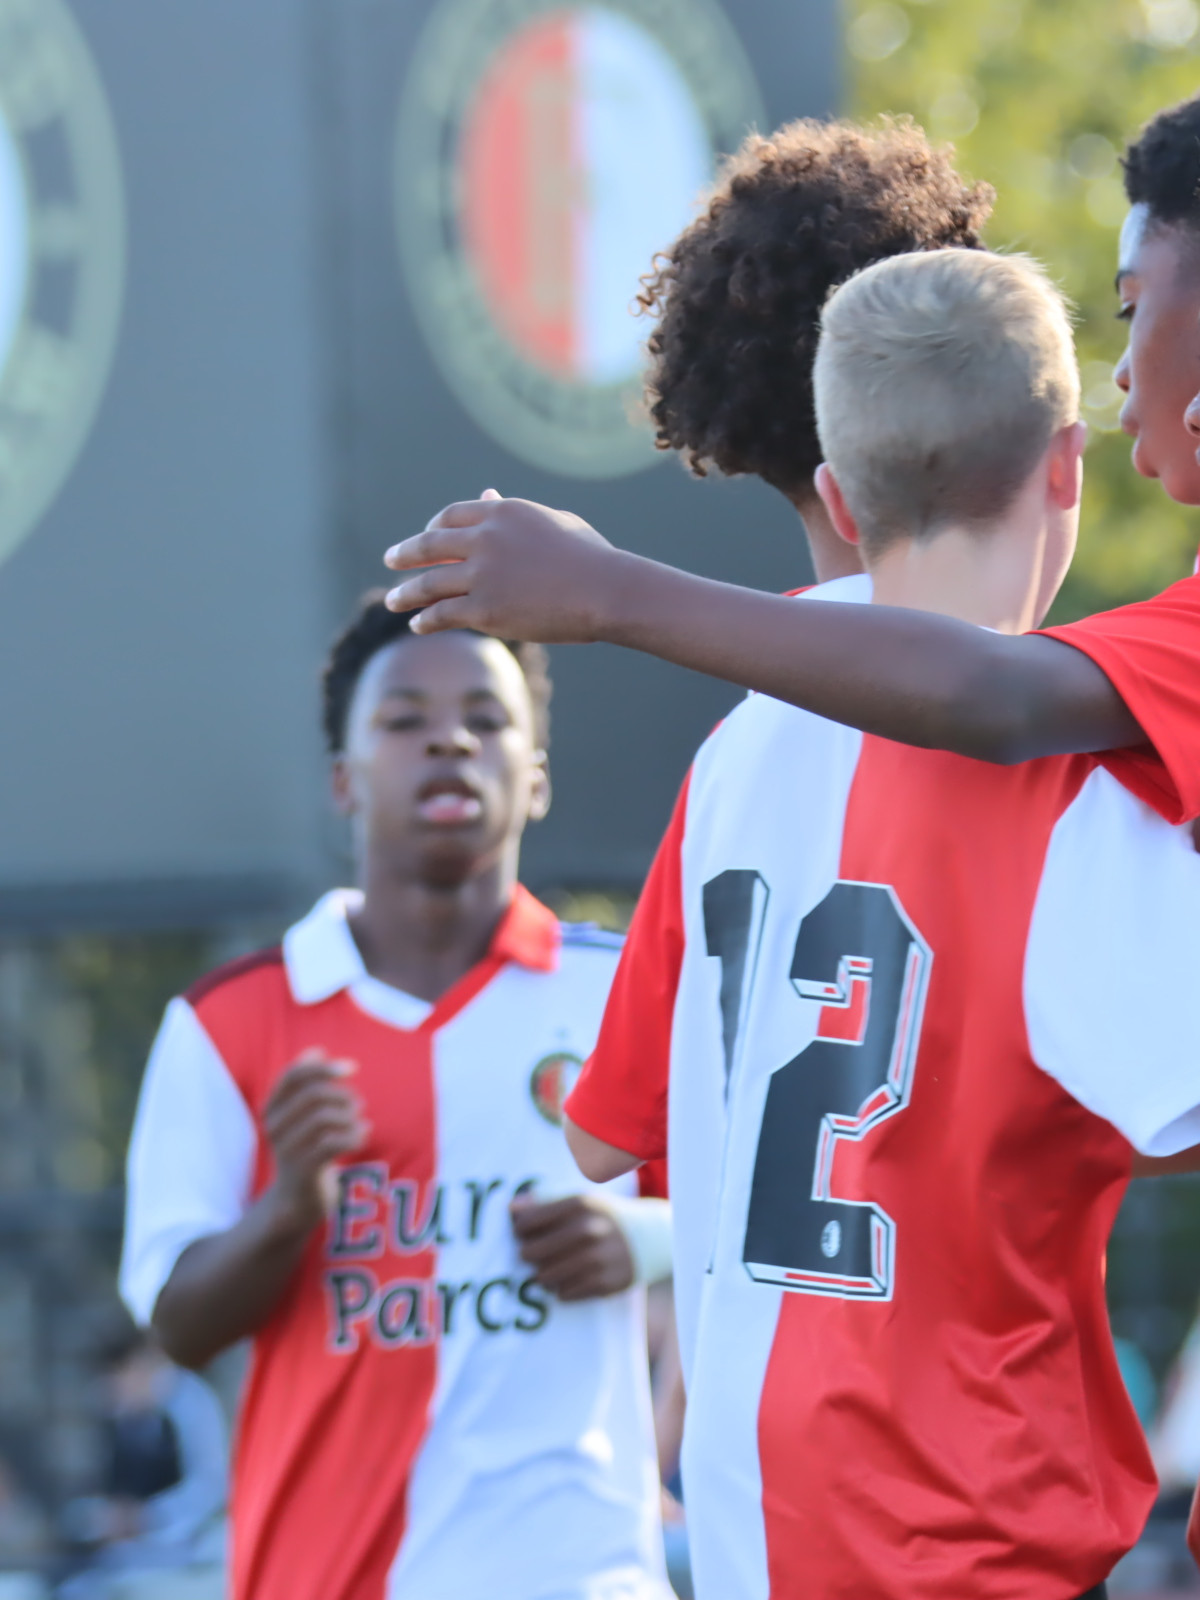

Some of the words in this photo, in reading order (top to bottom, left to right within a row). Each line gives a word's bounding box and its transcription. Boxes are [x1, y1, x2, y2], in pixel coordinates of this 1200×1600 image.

[701, 868, 934, 1302] 12
[330, 1165, 539, 1255] Eur
[329, 1270, 549, 1345] Parcs
